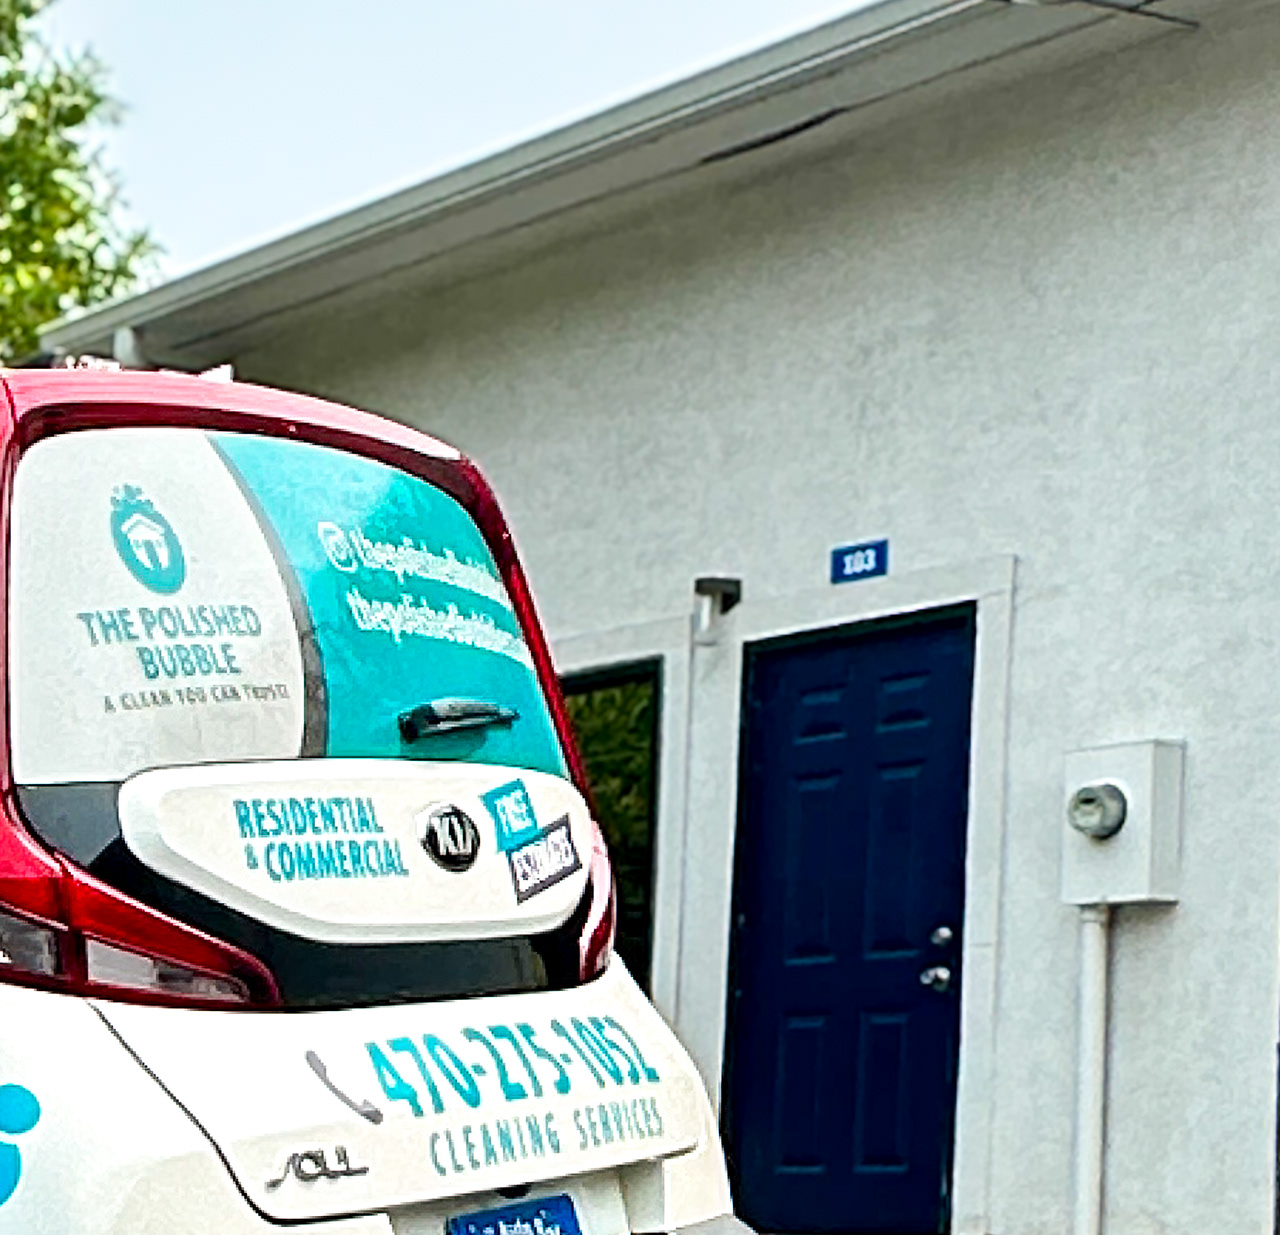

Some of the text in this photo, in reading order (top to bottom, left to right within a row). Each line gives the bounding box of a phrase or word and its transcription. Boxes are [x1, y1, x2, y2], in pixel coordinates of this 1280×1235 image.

[77, 604, 262, 647] THE POLISHED
[137, 643, 242, 680] BUBBLE
[233, 797, 384, 839] RESIDENTIAL
[264, 839, 409, 883] COMMERCIAL
[365, 1015, 660, 1117] 470-275-1052
[429, 1097, 663, 1176] CLEANING SERVICES
